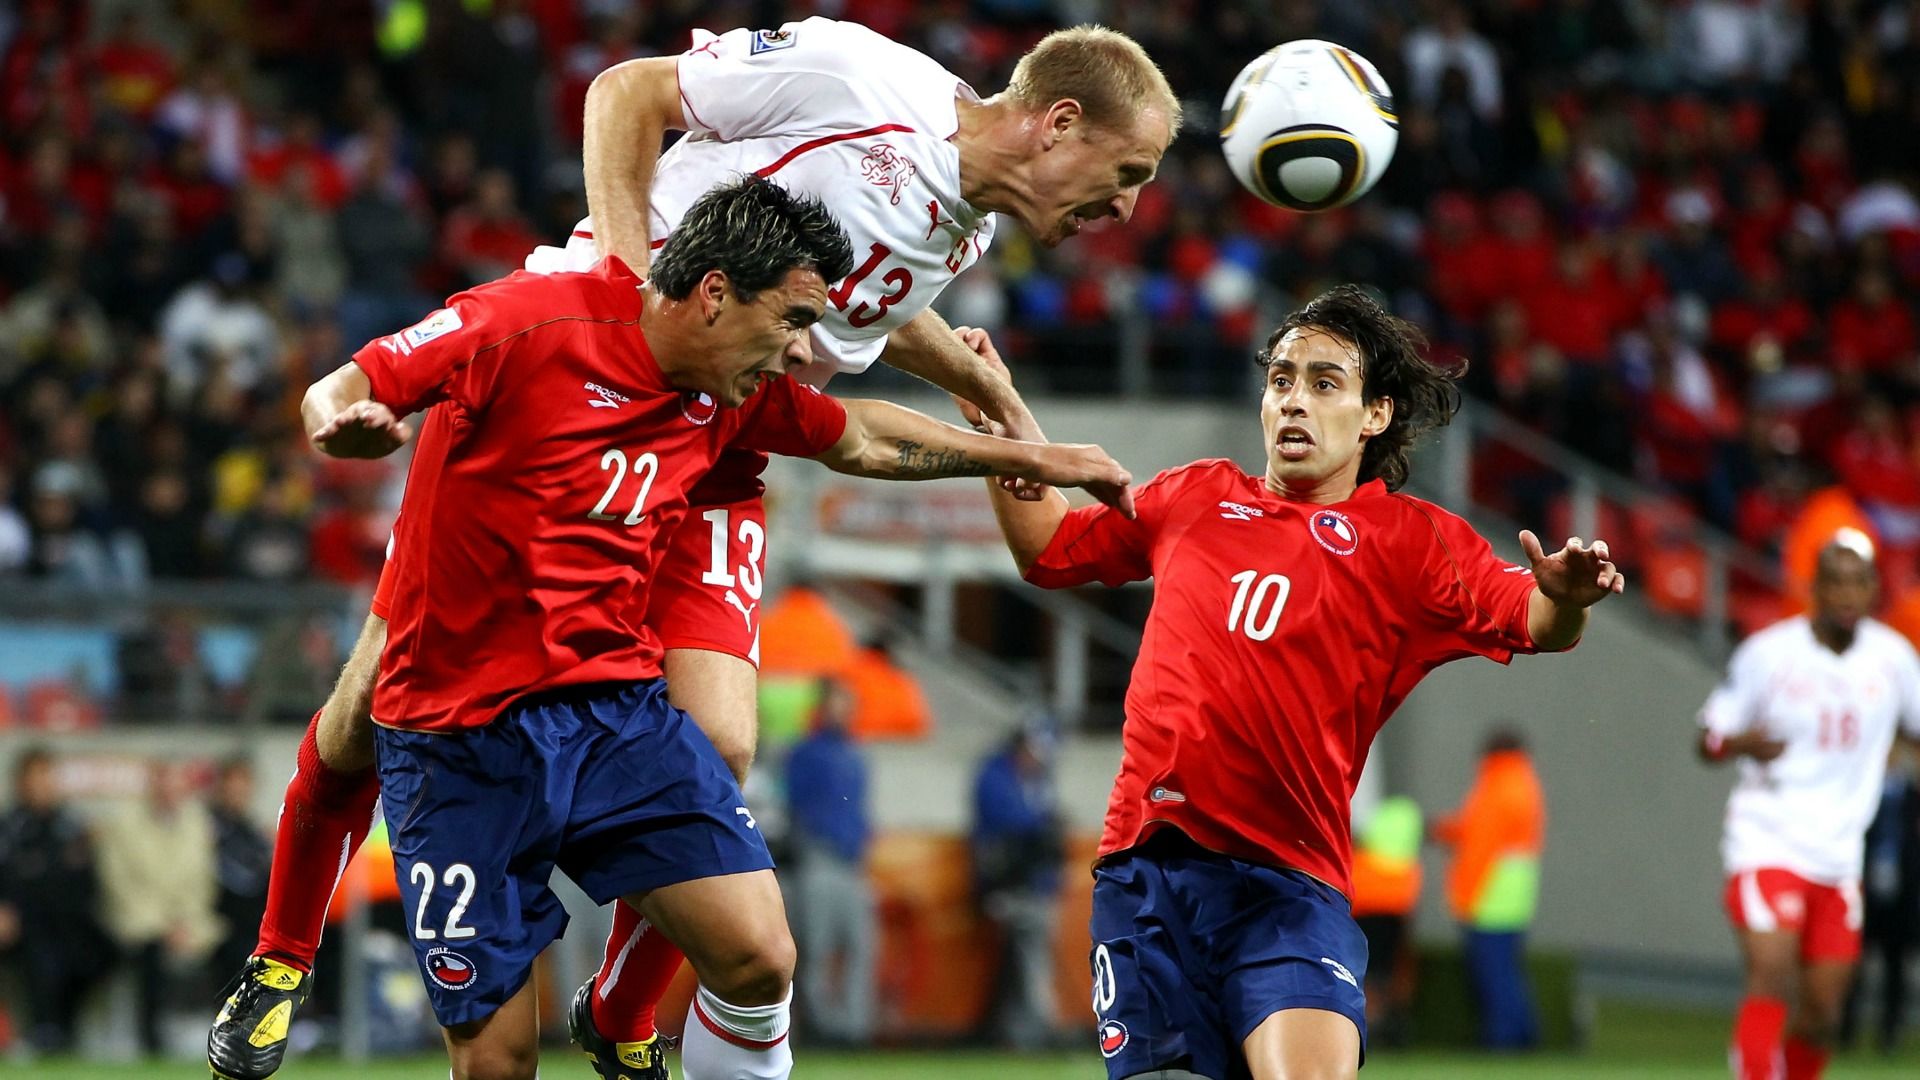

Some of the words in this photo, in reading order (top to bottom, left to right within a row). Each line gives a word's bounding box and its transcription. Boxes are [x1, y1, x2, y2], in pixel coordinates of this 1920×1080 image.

[828, 242, 913, 328] 13
[584, 381, 630, 402] BROOKS
[587, 449, 659, 526] 22
[1219, 500, 1264, 517] BROOKS
[702, 508, 765, 600] 13
[1228, 569, 1291, 642] 10
[410, 862, 477, 939] 22
[429, 946, 449, 956] CHILE
